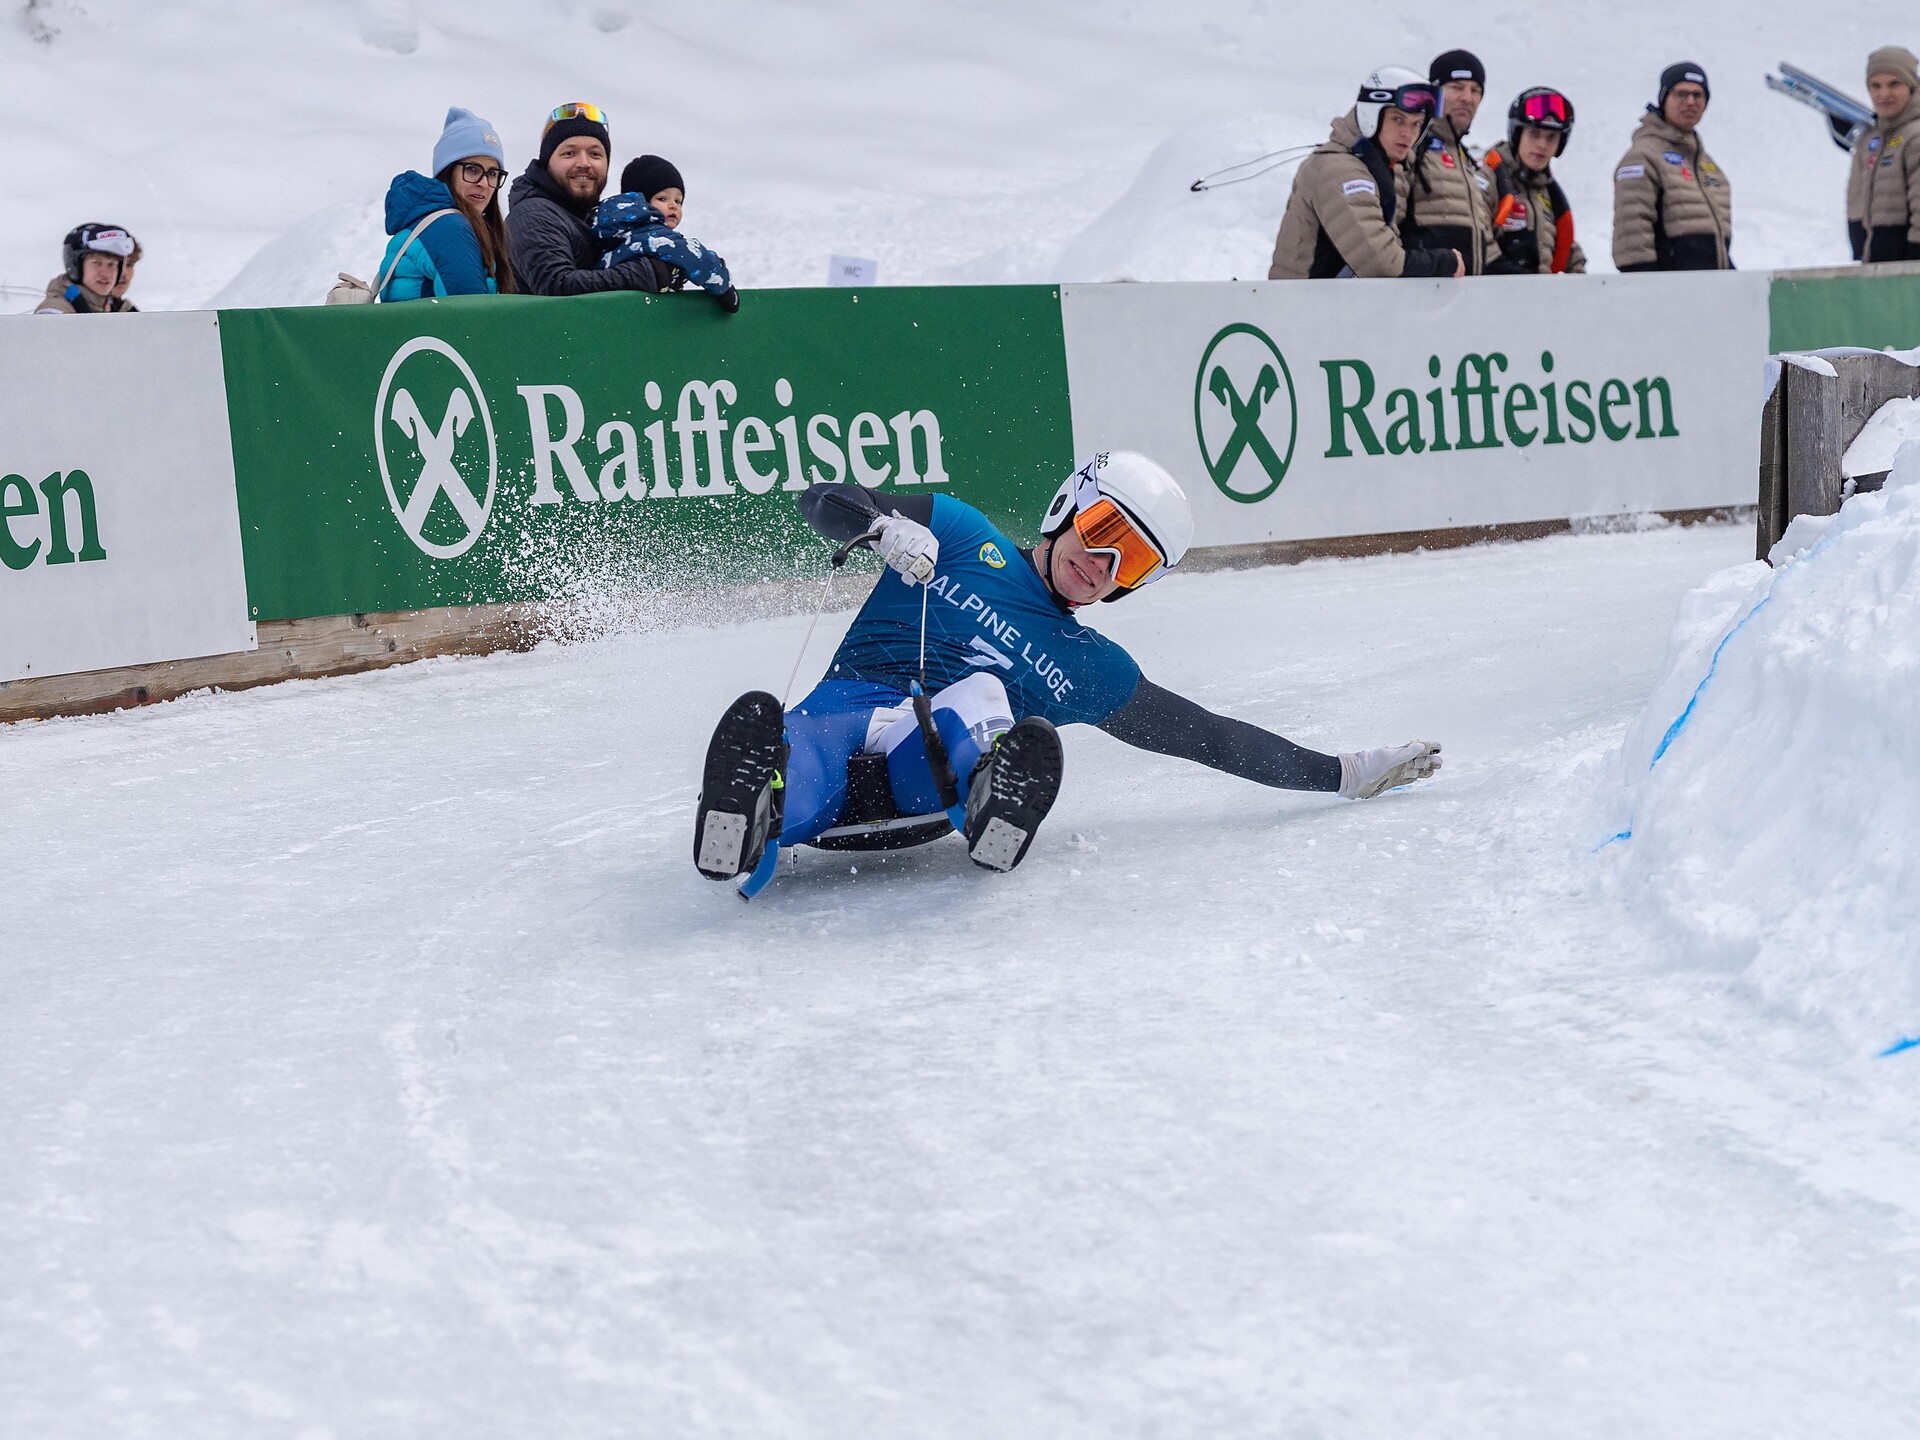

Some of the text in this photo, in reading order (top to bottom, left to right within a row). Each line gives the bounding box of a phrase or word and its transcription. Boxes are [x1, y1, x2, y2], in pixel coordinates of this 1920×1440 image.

[516, 377, 949, 504] Raiffeisen
[1319, 350, 1680, 458] Raiffeisen
[0, 469, 107, 571] en
[927, 574, 1074, 702] ALPINE LUGE
